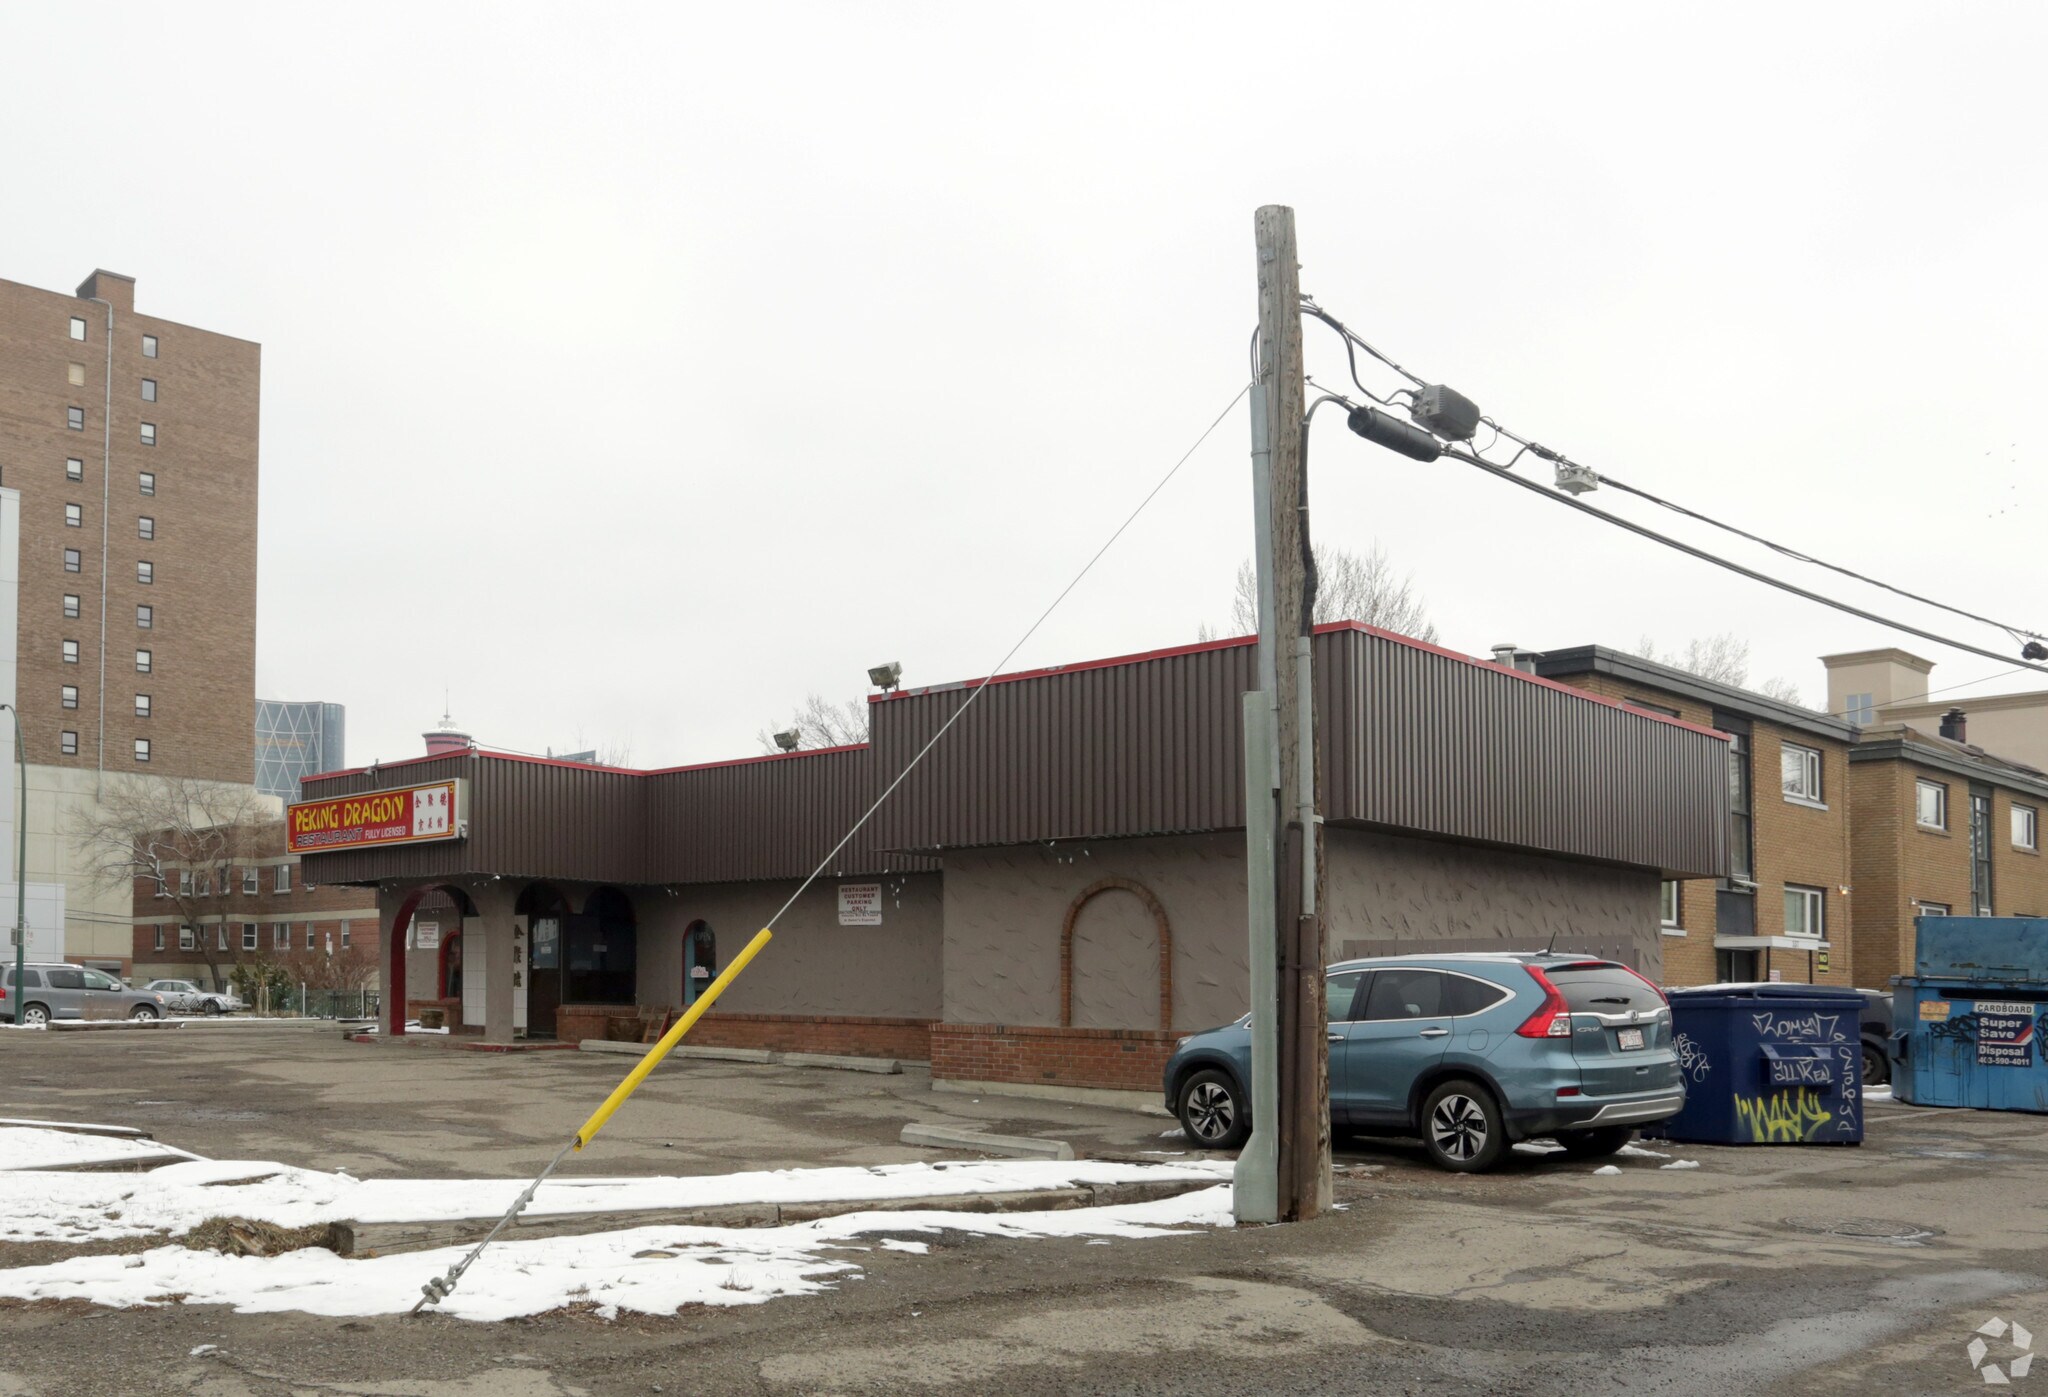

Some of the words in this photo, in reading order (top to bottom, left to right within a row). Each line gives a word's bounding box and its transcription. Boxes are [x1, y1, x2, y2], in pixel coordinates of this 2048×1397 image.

[296, 805, 338, 832] PEKING
[344, 795, 403, 826] DRAGON
[296, 828, 362, 846] RESTAURANT
[365, 829, 380, 839] FULLY
[381, 826, 405, 837] LICENSED
[1977, 1004, 2032, 1013] CARDBOARD
[1980, 1018, 2022, 1029] Super
[1980, 1029, 2015, 1038] Save
[1979, 1045, 2024, 1056] Disposal
